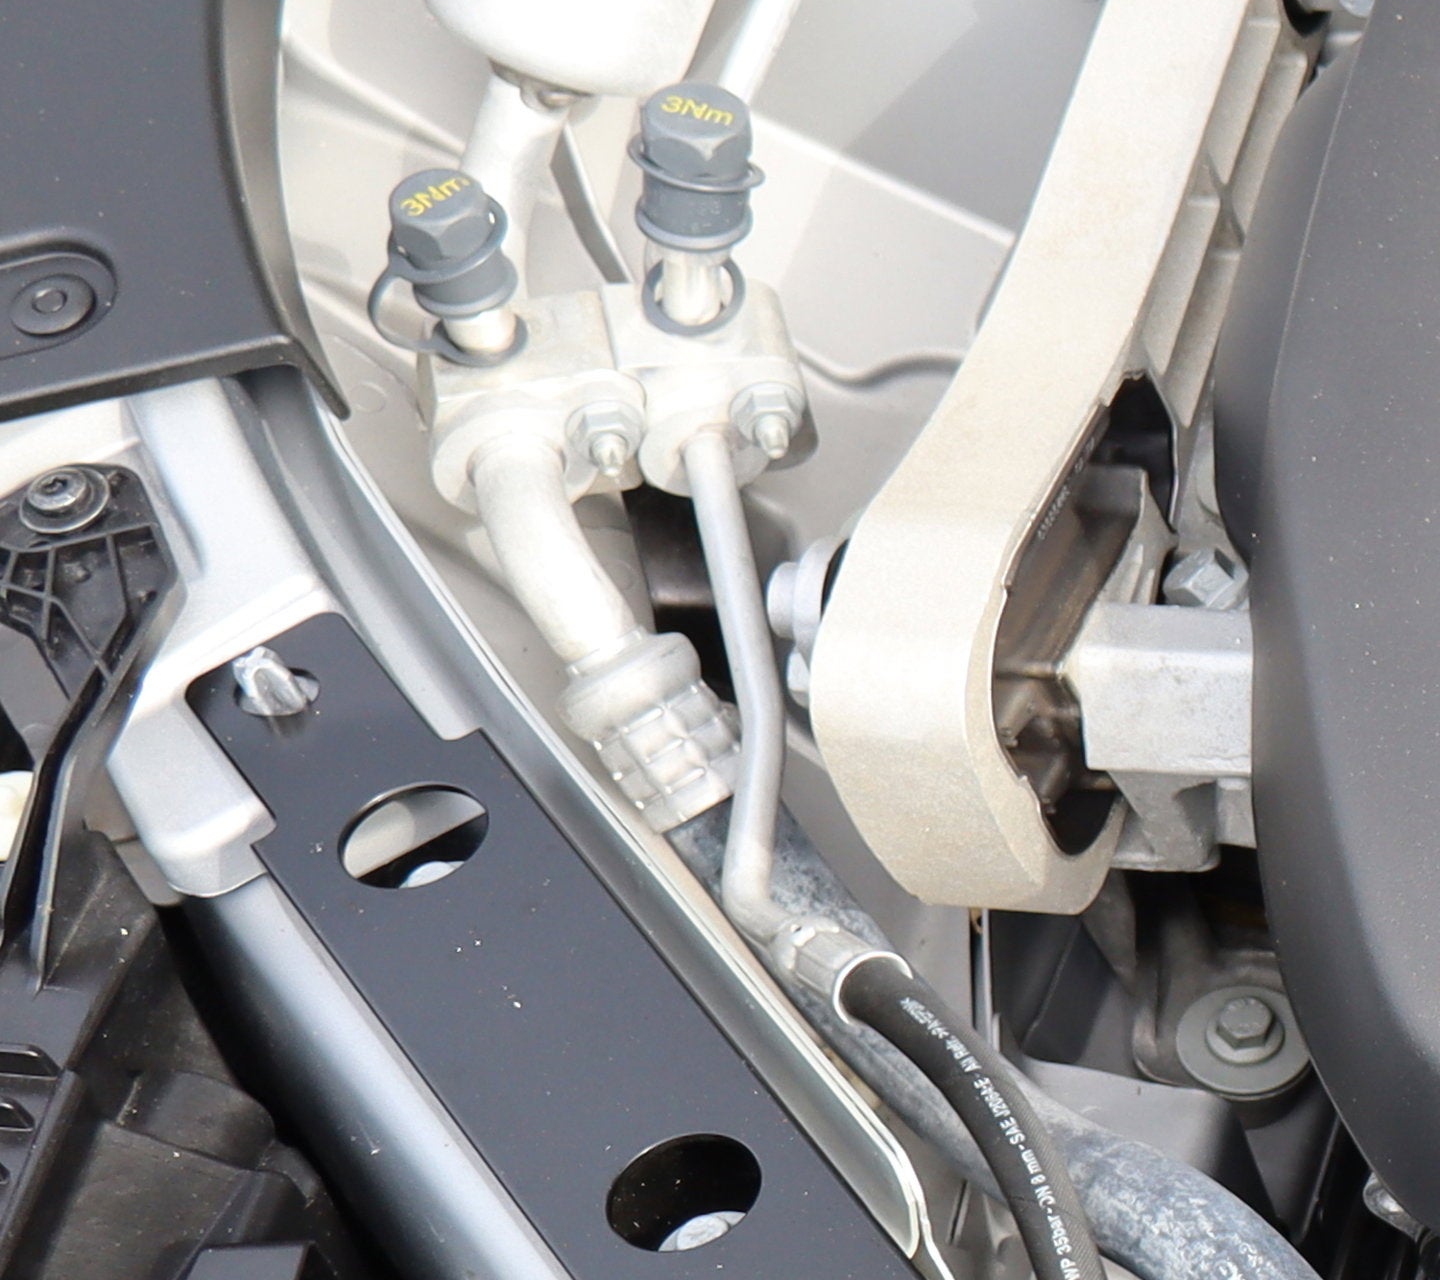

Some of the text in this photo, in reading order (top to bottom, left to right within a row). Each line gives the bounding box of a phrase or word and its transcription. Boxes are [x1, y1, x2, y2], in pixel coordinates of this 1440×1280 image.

[660, 95, 734, 126] 3Nm
[400, 177, 469, 217] 3Nm
[1000, 1117, 1025, 1145] SAE
[1021, 1149, 1042, 1174] mm
[1047, 1215, 1072, 1255] 35bar
